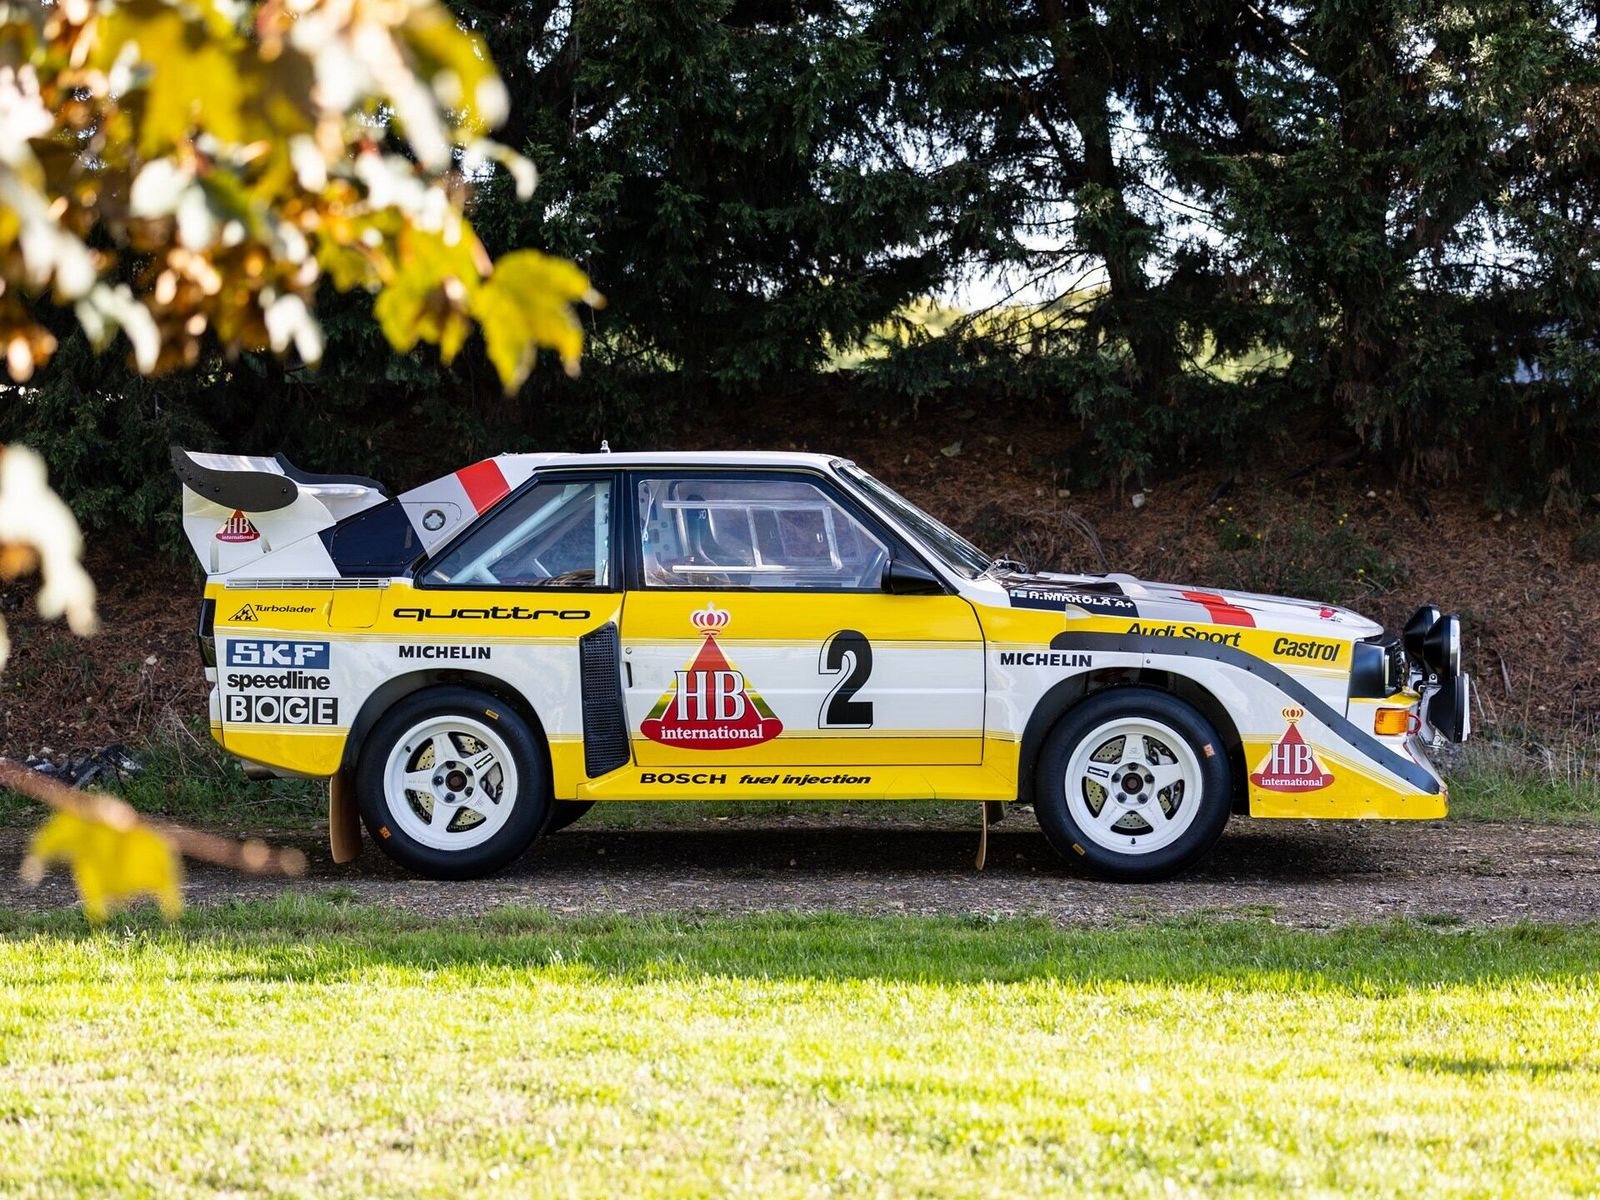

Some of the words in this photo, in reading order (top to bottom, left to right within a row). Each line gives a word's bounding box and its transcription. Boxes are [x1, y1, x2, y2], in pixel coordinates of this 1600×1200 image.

[227, 517, 249, 534] HB
[255, 604, 316, 613] Turbolader
[393, 606, 591, 622] quattro
[1127, 622, 1176, 638] Audi
[1181, 626, 1241, 647] Sport
[232, 642, 324, 666] SKF
[398, 645, 491, 659] MICHELIN
[1273, 637, 1341, 662] Castrol
[1000, 652, 1092, 667] MICHELIN
[227, 670, 331, 692] speedline
[818, 629, 873, 729] 2
[674, 670, 747, 721] HB
[230, 696, 334, 724] BOGE
[660, 724, 764, 740] international
[1271, 743, 1313, 775] HB
[640, 773, 727, 785] BOSCH
[739, 774, 779, 785] fuel
[782, 774, 871, 786] injection
[1261, 776, 1323, 787] international
